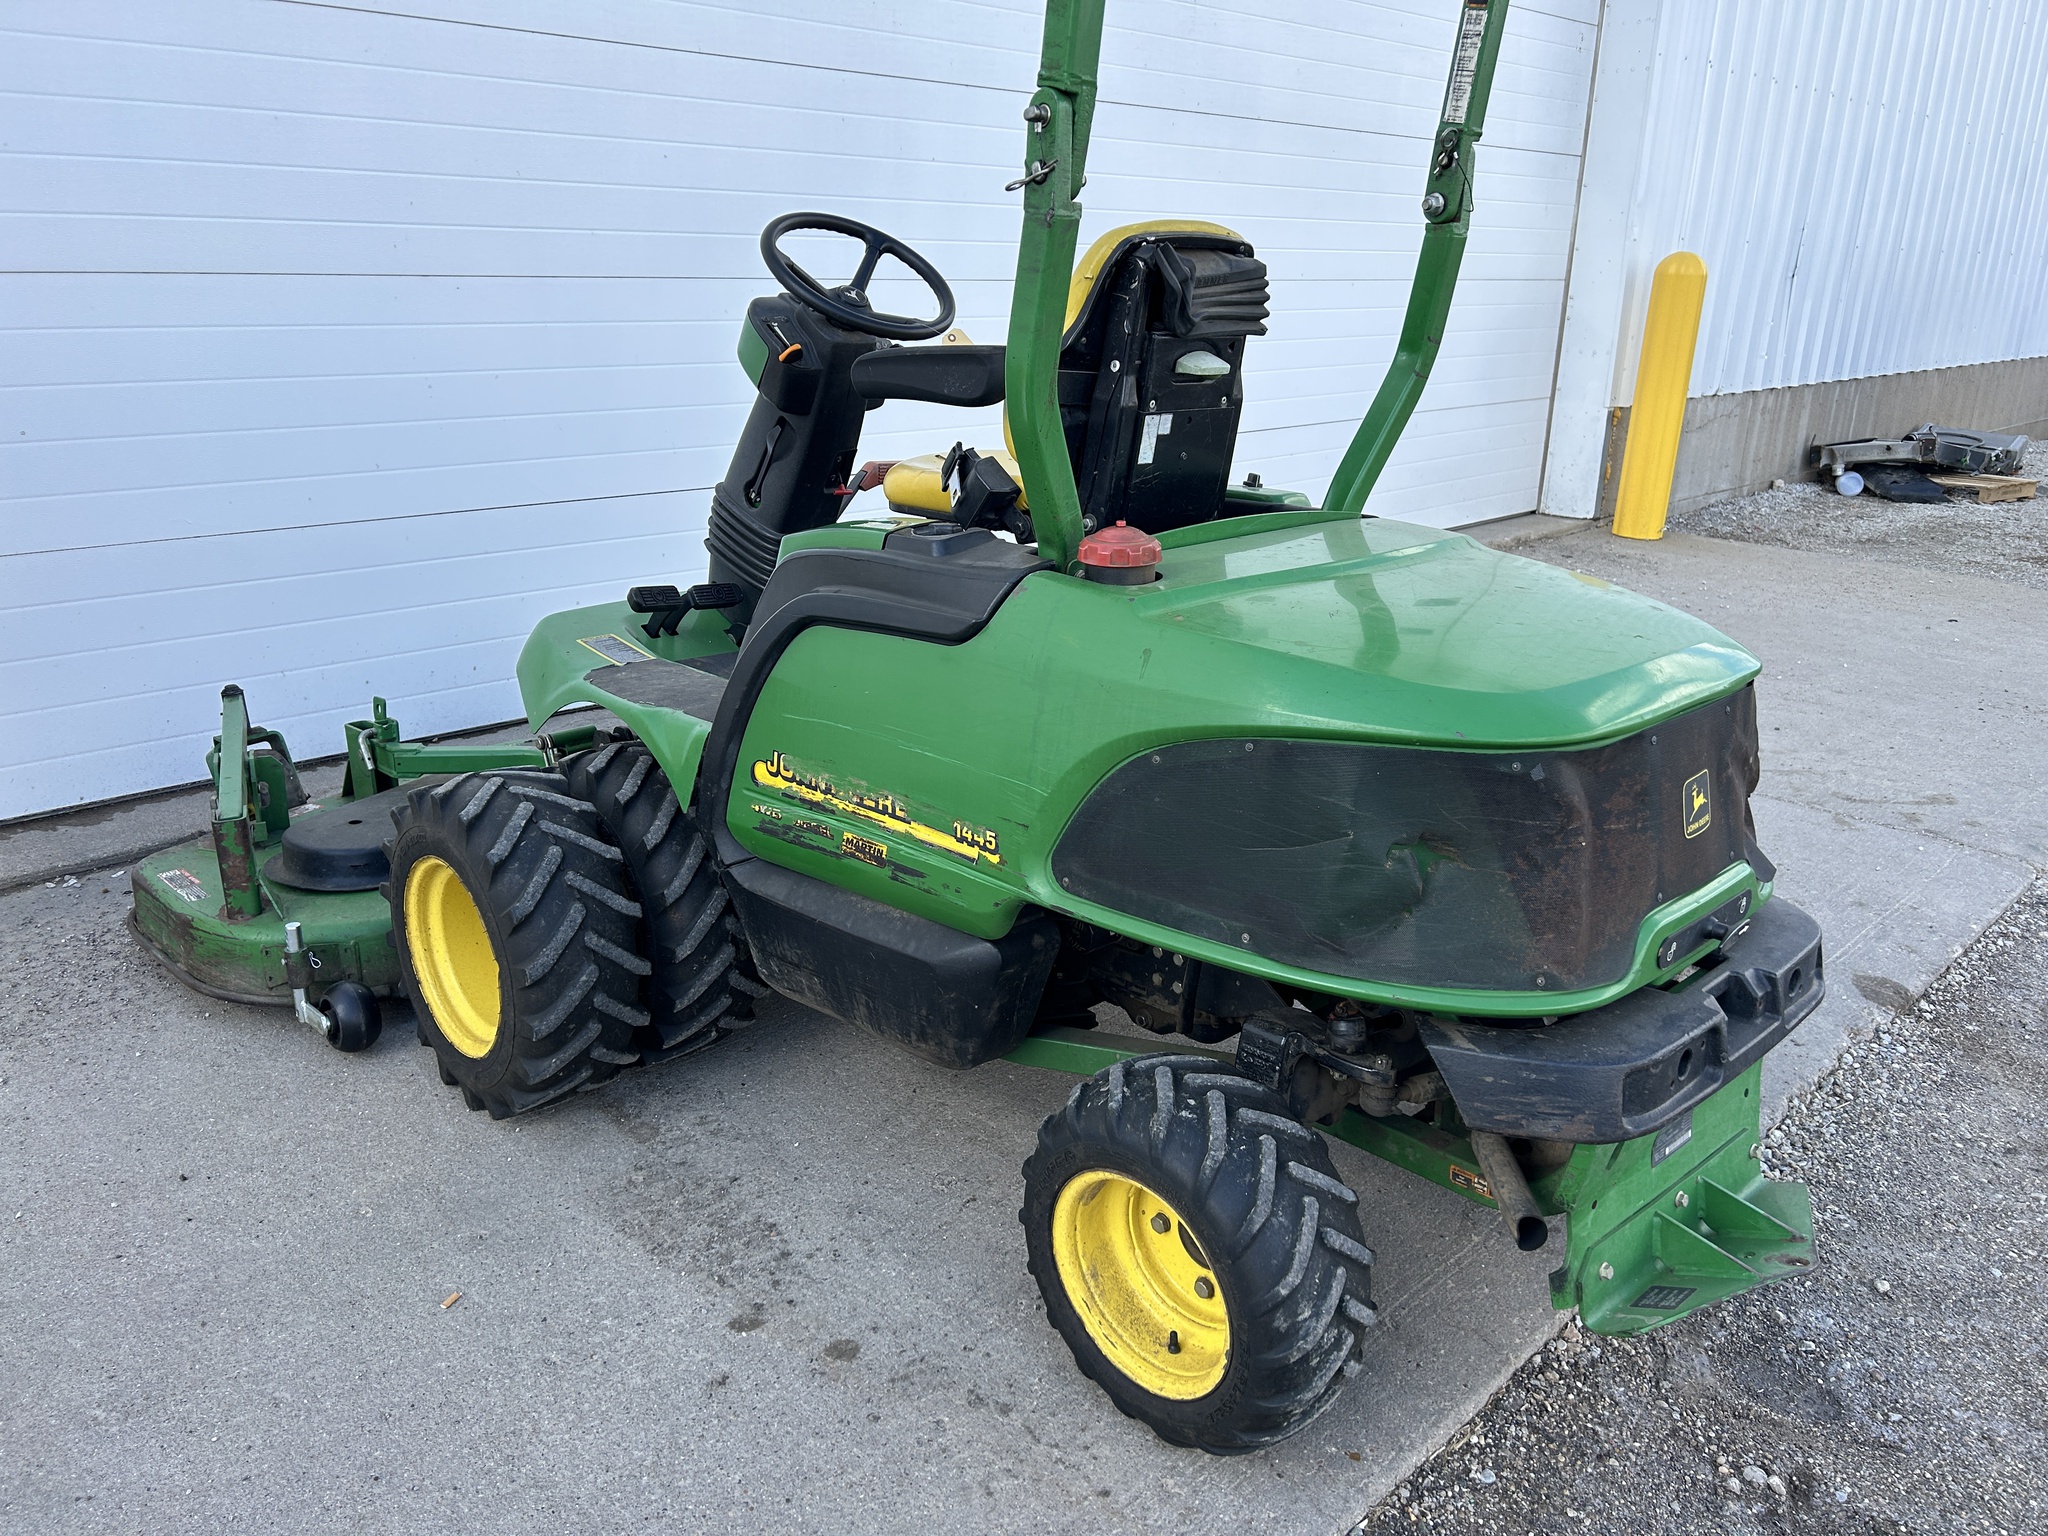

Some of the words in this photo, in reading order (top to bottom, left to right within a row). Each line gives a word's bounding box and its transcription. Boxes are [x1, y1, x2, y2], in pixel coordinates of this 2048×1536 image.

[1687, 822, 1698, 833] JOHN
[1699, 814, 1709, 826] DEERE
[845, 836, 884, 858] MARTIN
[953, 820, 998, 853] 1445
